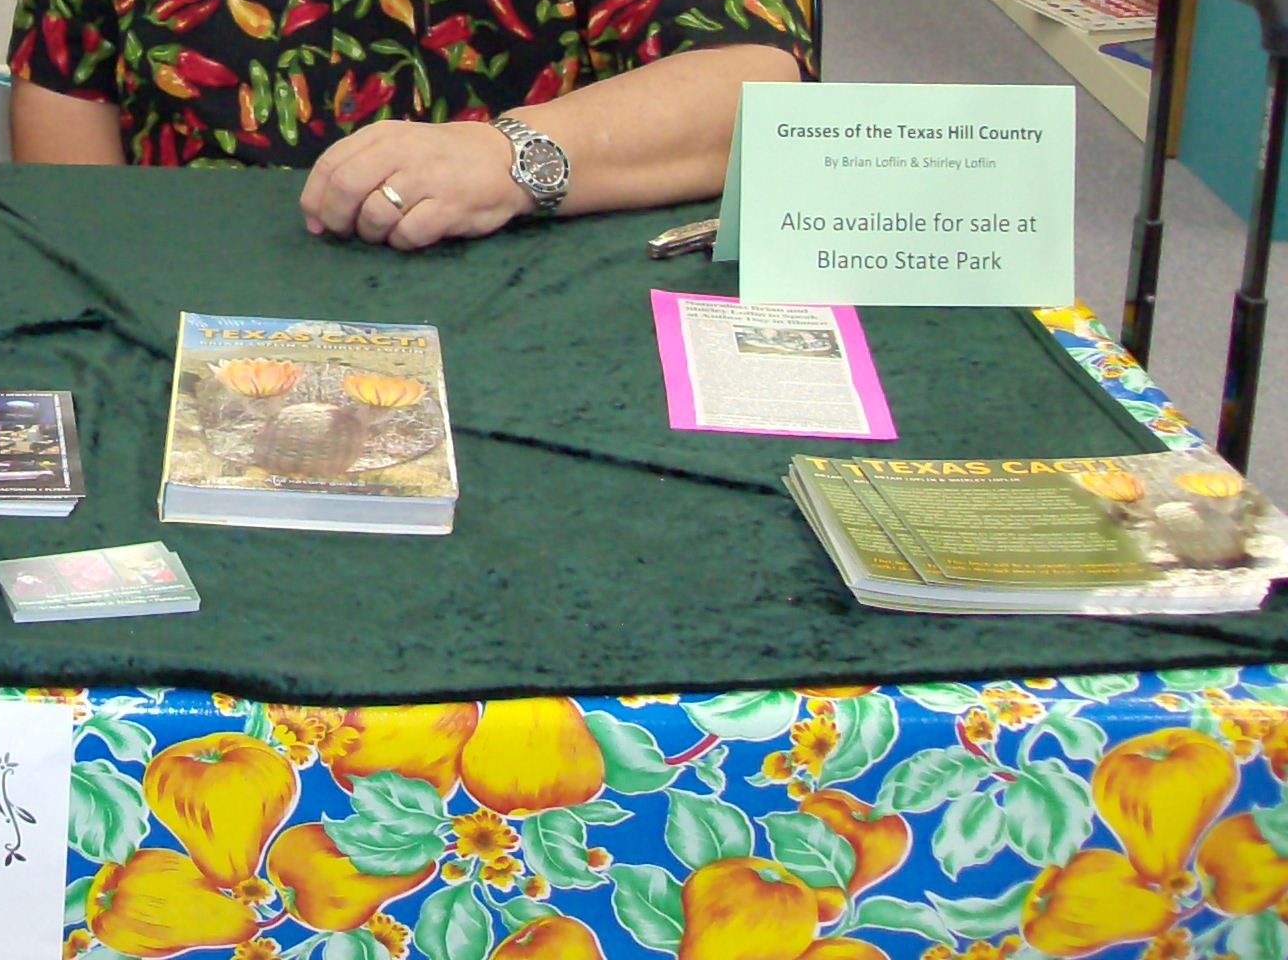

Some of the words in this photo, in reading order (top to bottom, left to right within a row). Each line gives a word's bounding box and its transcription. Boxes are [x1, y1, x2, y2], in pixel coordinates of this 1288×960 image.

[776, 123, 840, 139] Grasses
[844, 123, 862, 139] of
[866, 124, 893, 139] the
[897, 125, 943, 140] Texas
[948, 125, 974, 140] Hill
[978, 126, 1043, 143] Country
[824, 156, 838, 169] By
[842, 156, 872, 168] Brian
[875, 156, 907, 168] Loflin
[911, 157, 919, 168] &
[923, 157, 962, 170] Shirley
[964, 158, 997, 169] Loflin
[780, 212, 826, 232] Also
[832, 212, 927, 232] available
[933, 212, 964, 232] for
[970, 213, 1010, 232] sale
[1017, 215, 1037, 233] at
[817, 250, 888, 269] Blanco
[895, 251, 949, 270] State
[956, 251, 1002, 270] Park
[199, 327, 313, 342] TEXAS
[319, 333, 426, 348] CACTI
[862, 459, 992, 476] TEXAS
[1001, 459, 1123, 476] CACTI
